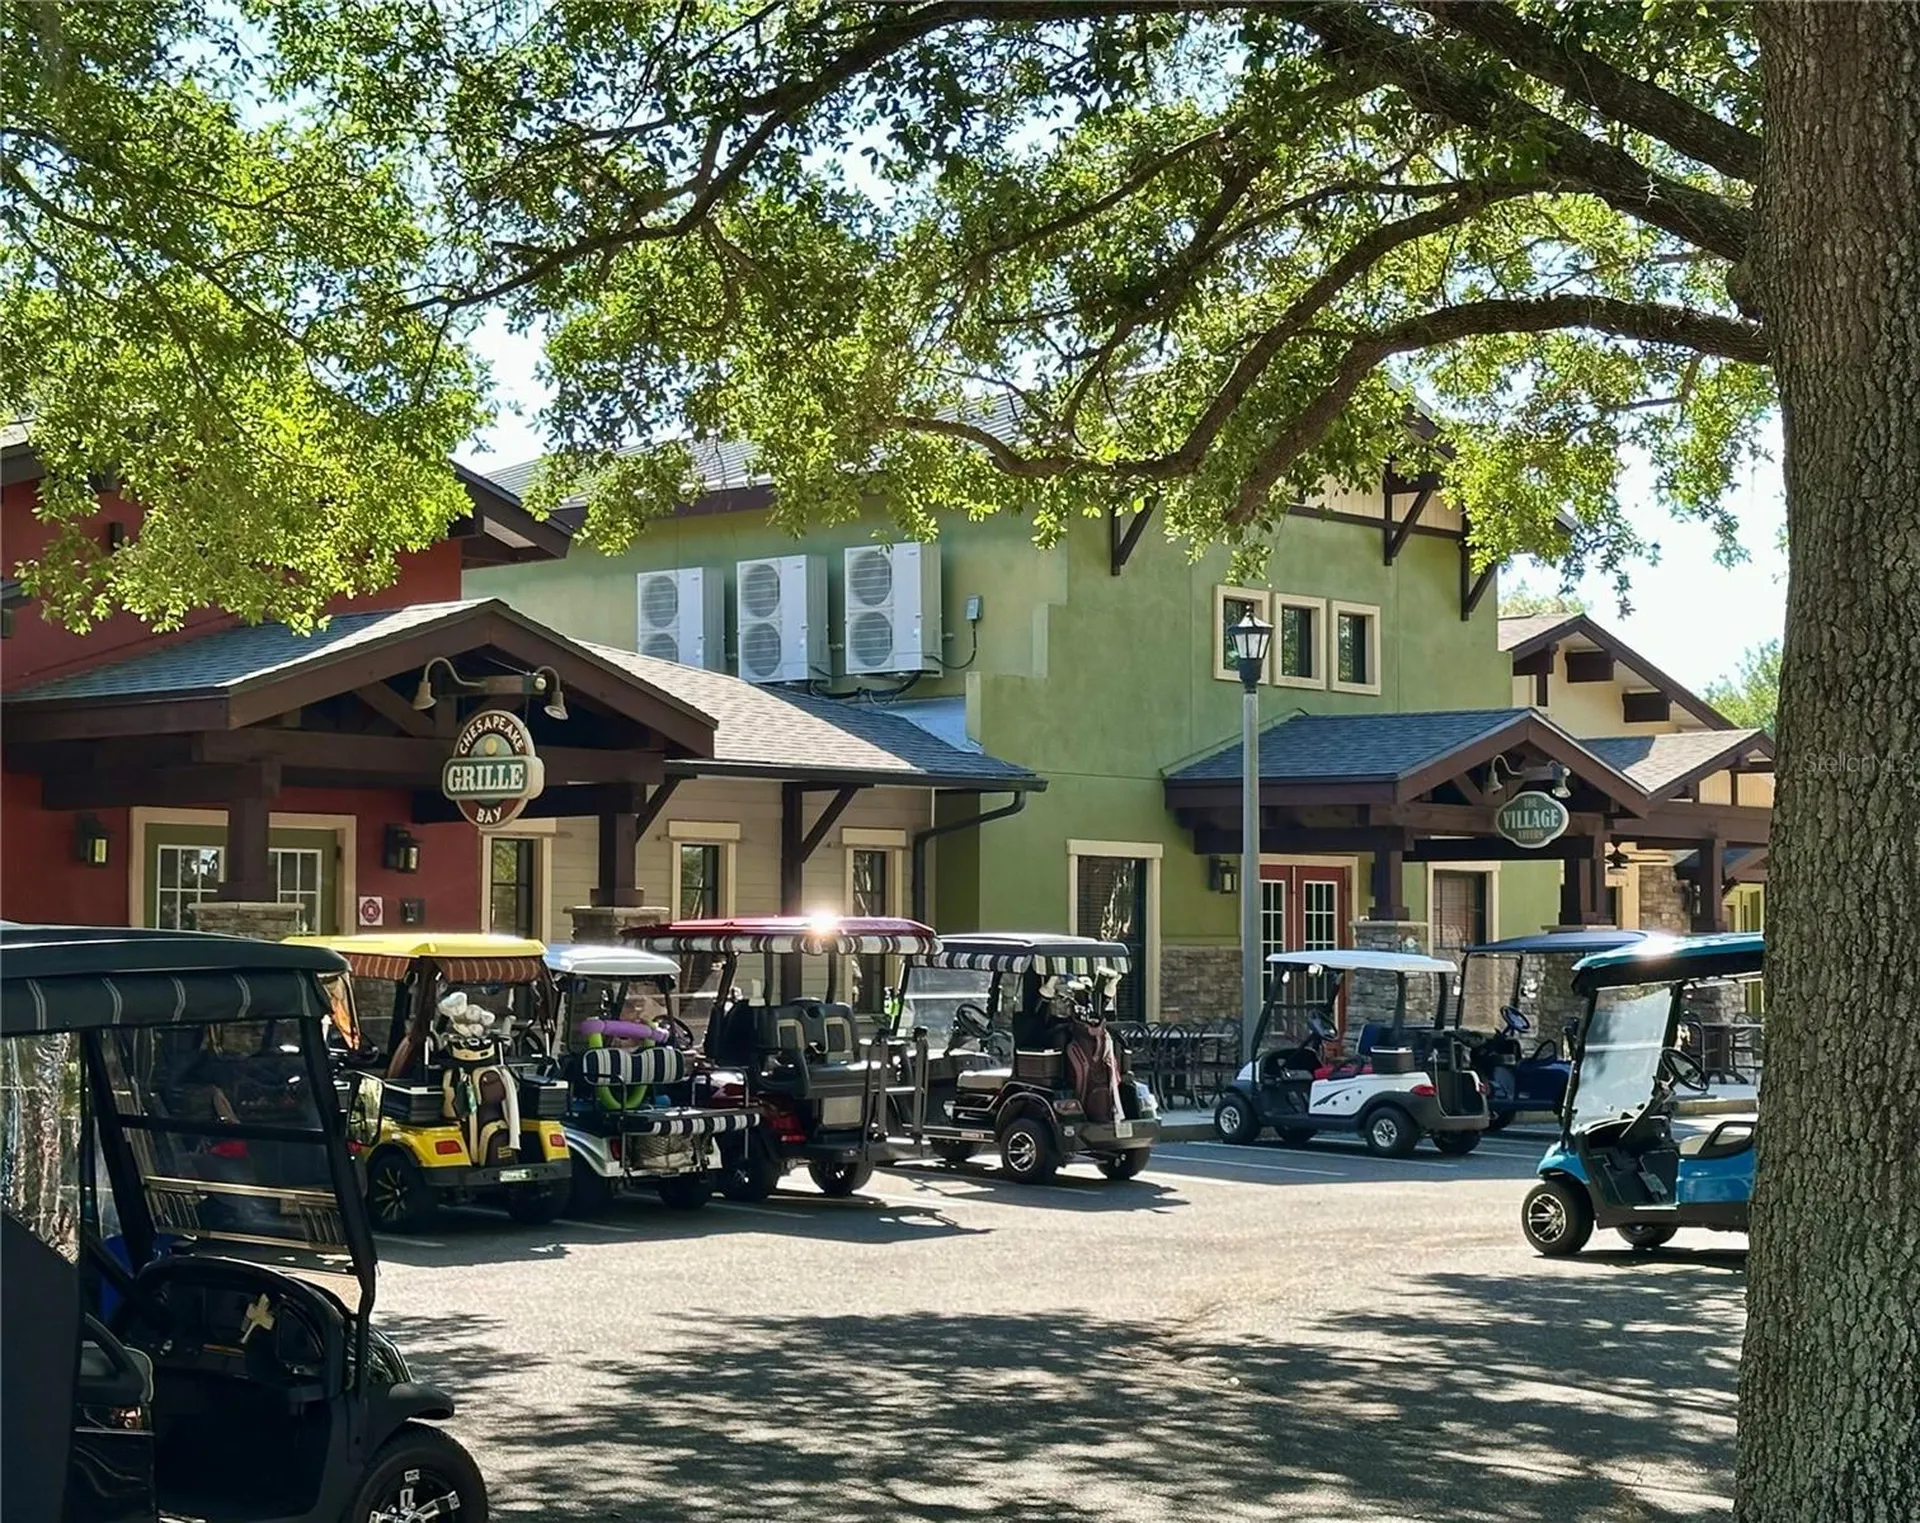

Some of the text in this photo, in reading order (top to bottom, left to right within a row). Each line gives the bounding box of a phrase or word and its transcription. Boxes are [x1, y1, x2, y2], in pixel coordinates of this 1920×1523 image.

[459, 715, 525, 754] CHESAPEAKE
[447, 764, 524, 792] GRILLE
[476, 807, 502, 823] BAY
[1503, 809, 1559, 829] VILLAGE
